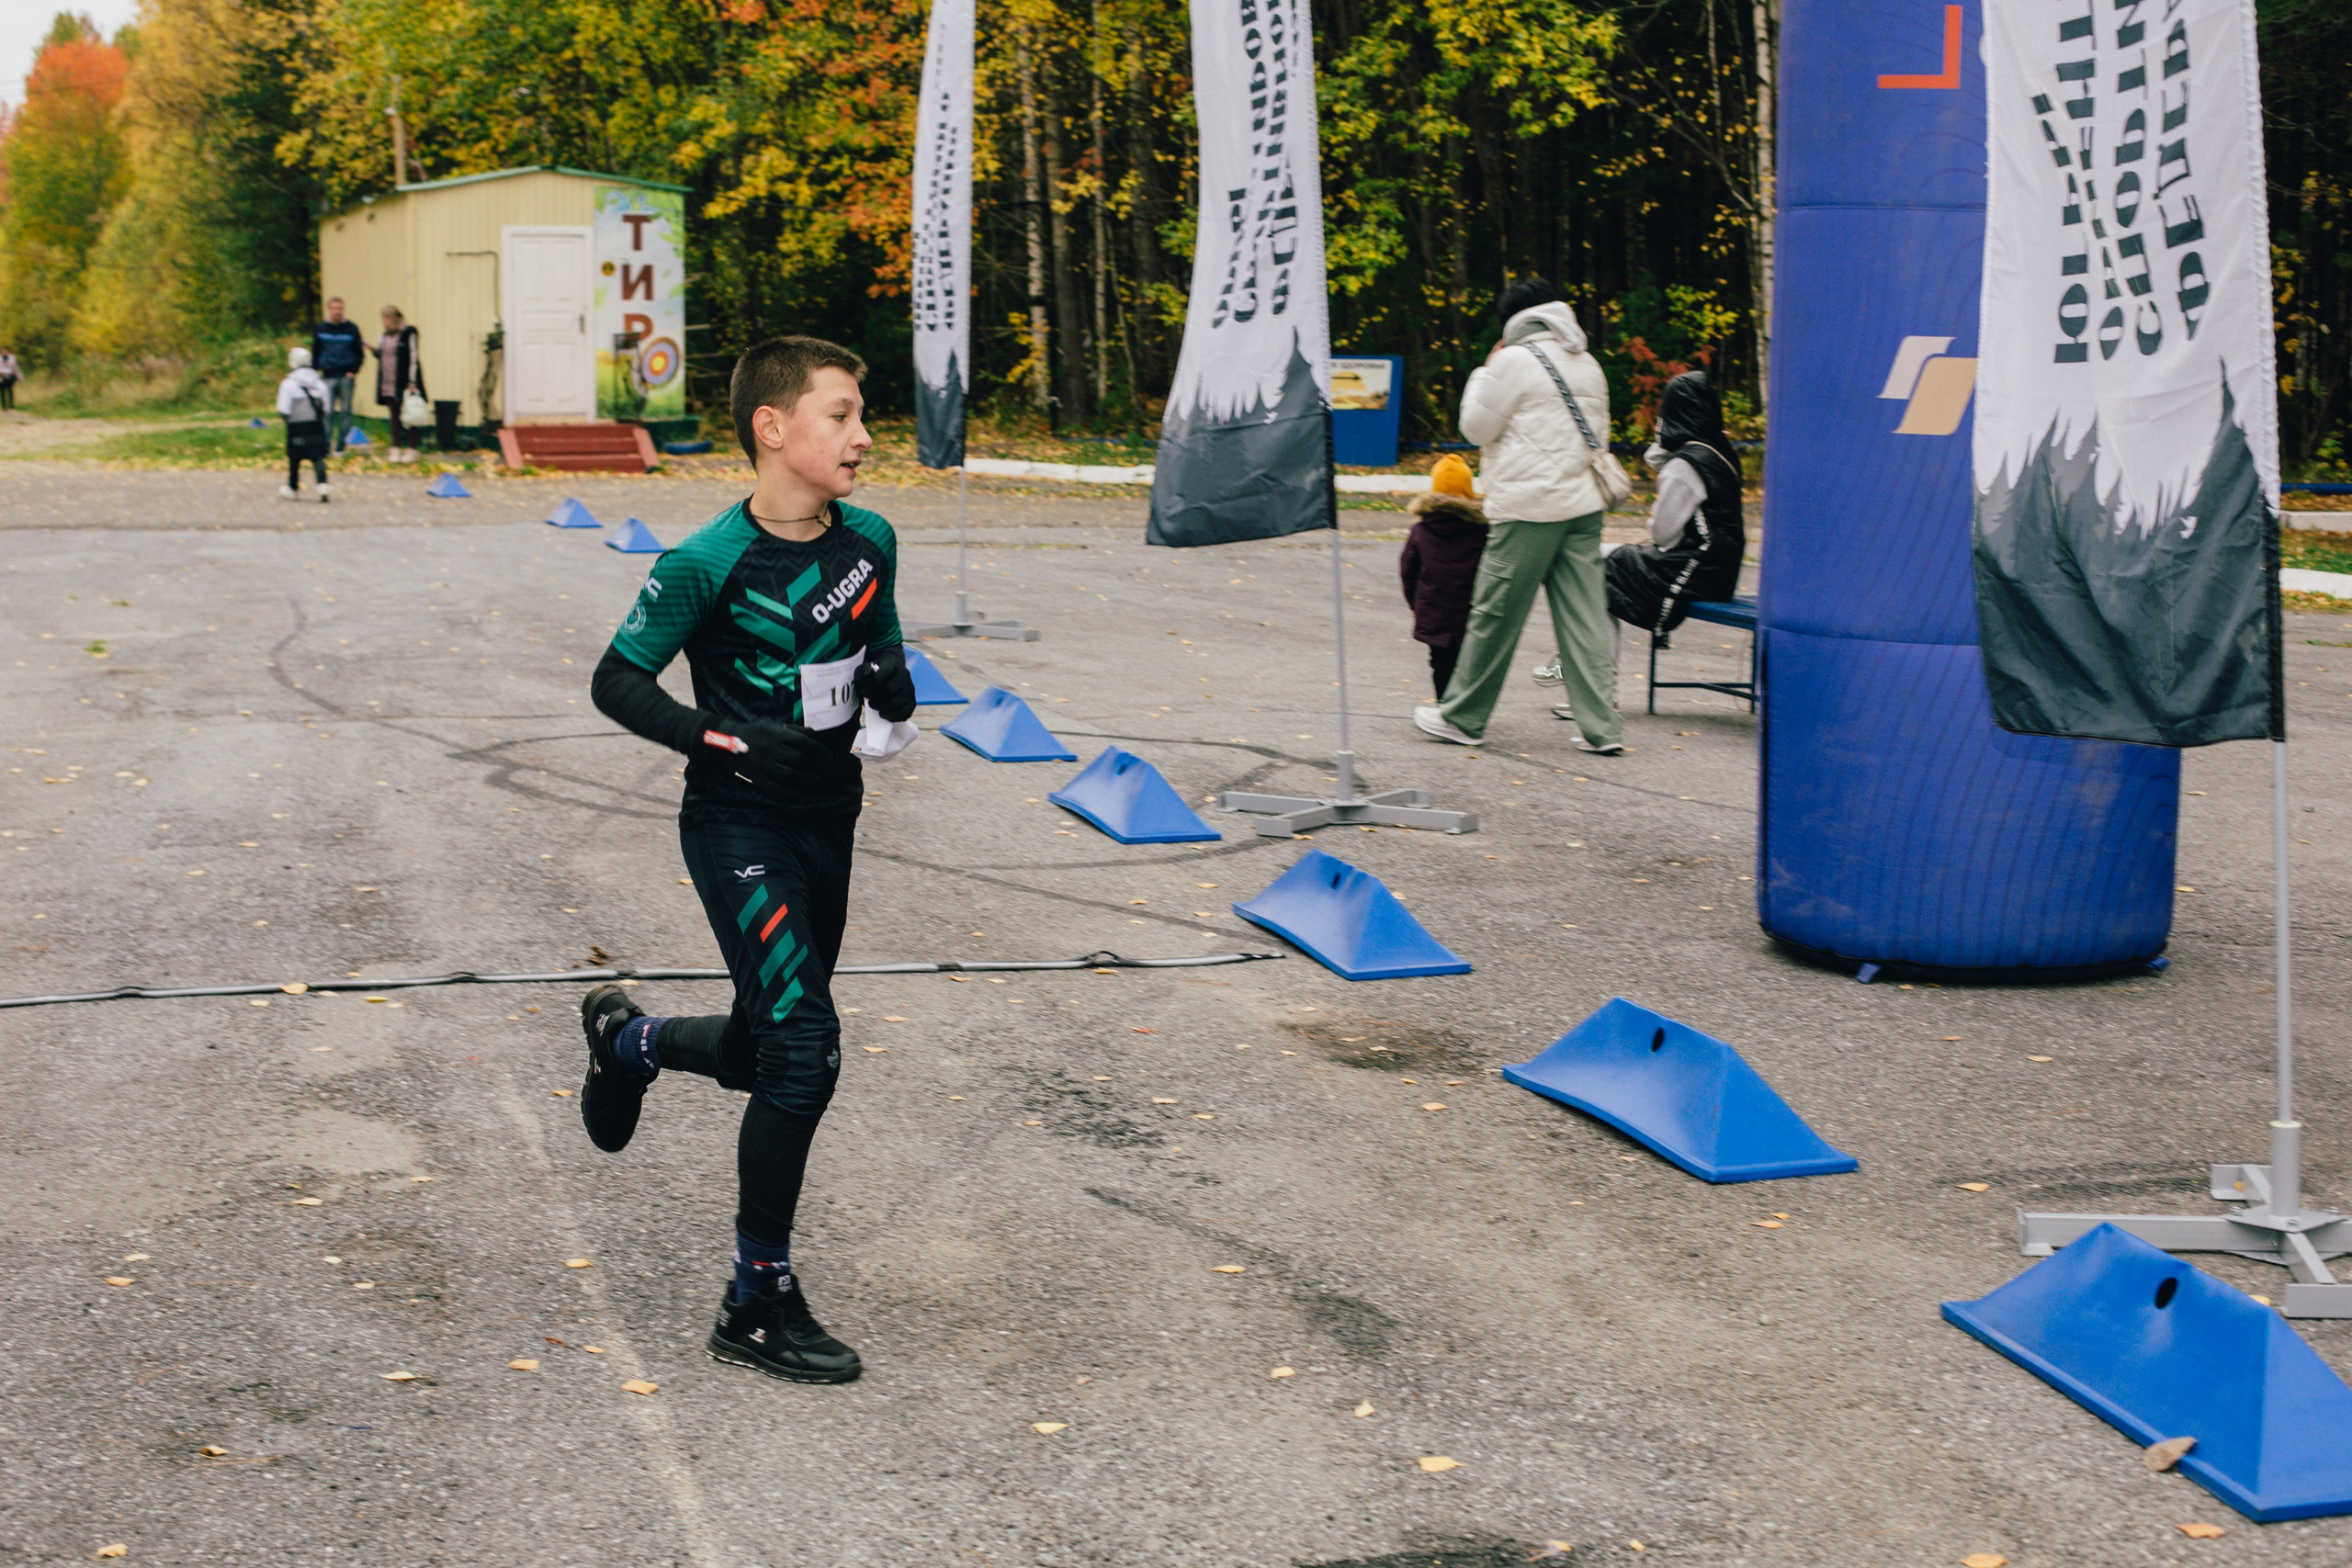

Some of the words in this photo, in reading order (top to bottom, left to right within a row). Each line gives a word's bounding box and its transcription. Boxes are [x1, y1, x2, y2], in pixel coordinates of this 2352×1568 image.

[622, 214, 655, 347] ТИР
[812, 558, 873, 624] O-UGRA
[831, 680, 854, 706] 10
